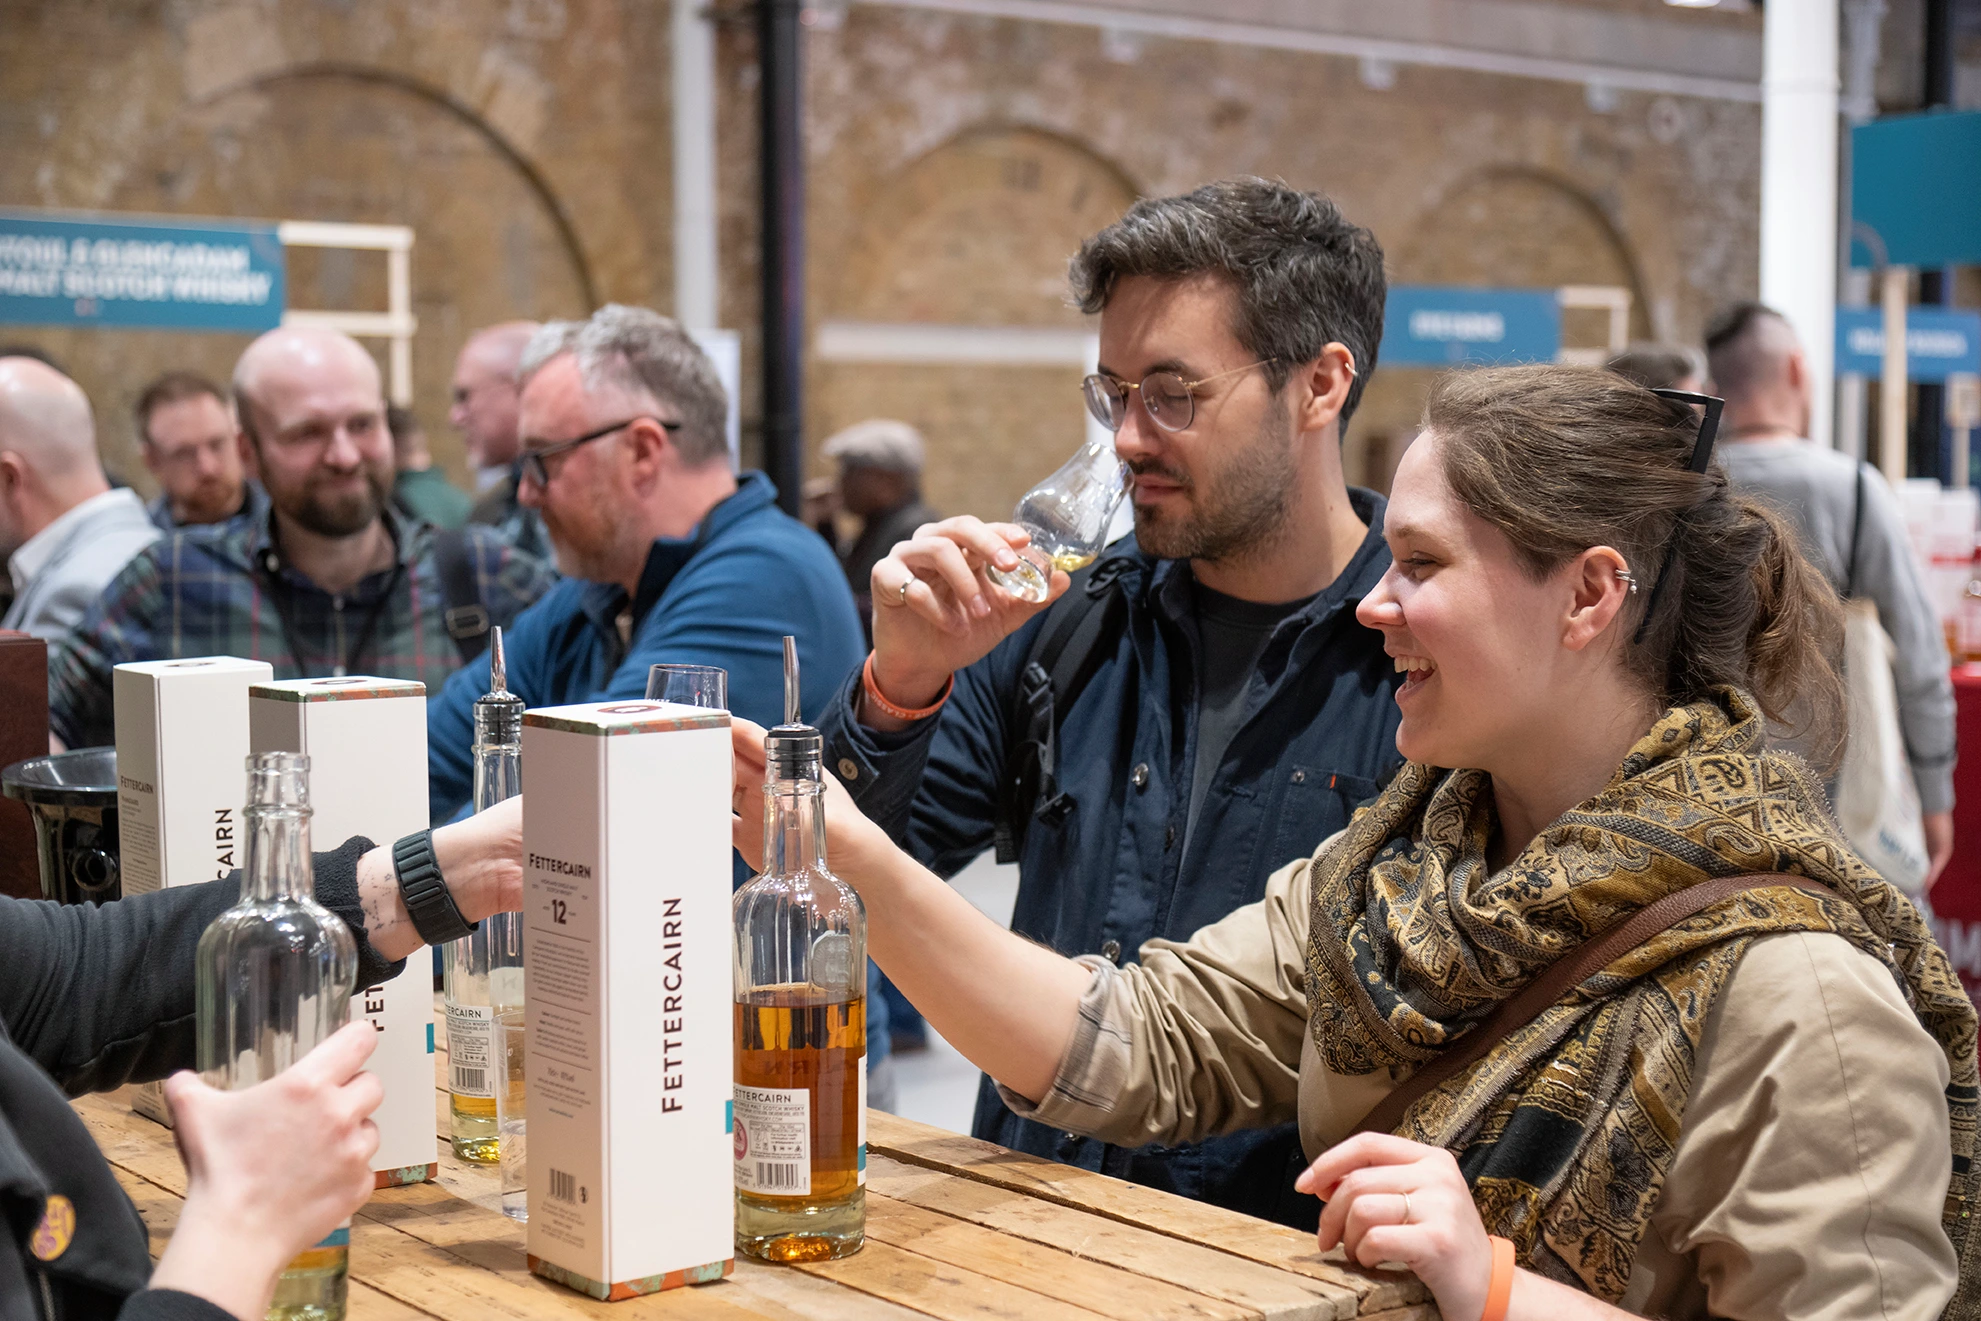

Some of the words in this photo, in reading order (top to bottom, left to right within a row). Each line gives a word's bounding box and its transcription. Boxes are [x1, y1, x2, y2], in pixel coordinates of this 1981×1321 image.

[120, 775, 154, 794] FETTERCAIRN
[215, 808, 234, 879] AIRN
[529, 853, 591, 879] FETTERCAIRN
[551, 899, 567, 925] 12
[661, 898, 683, 1114] FETTERCAIRN
